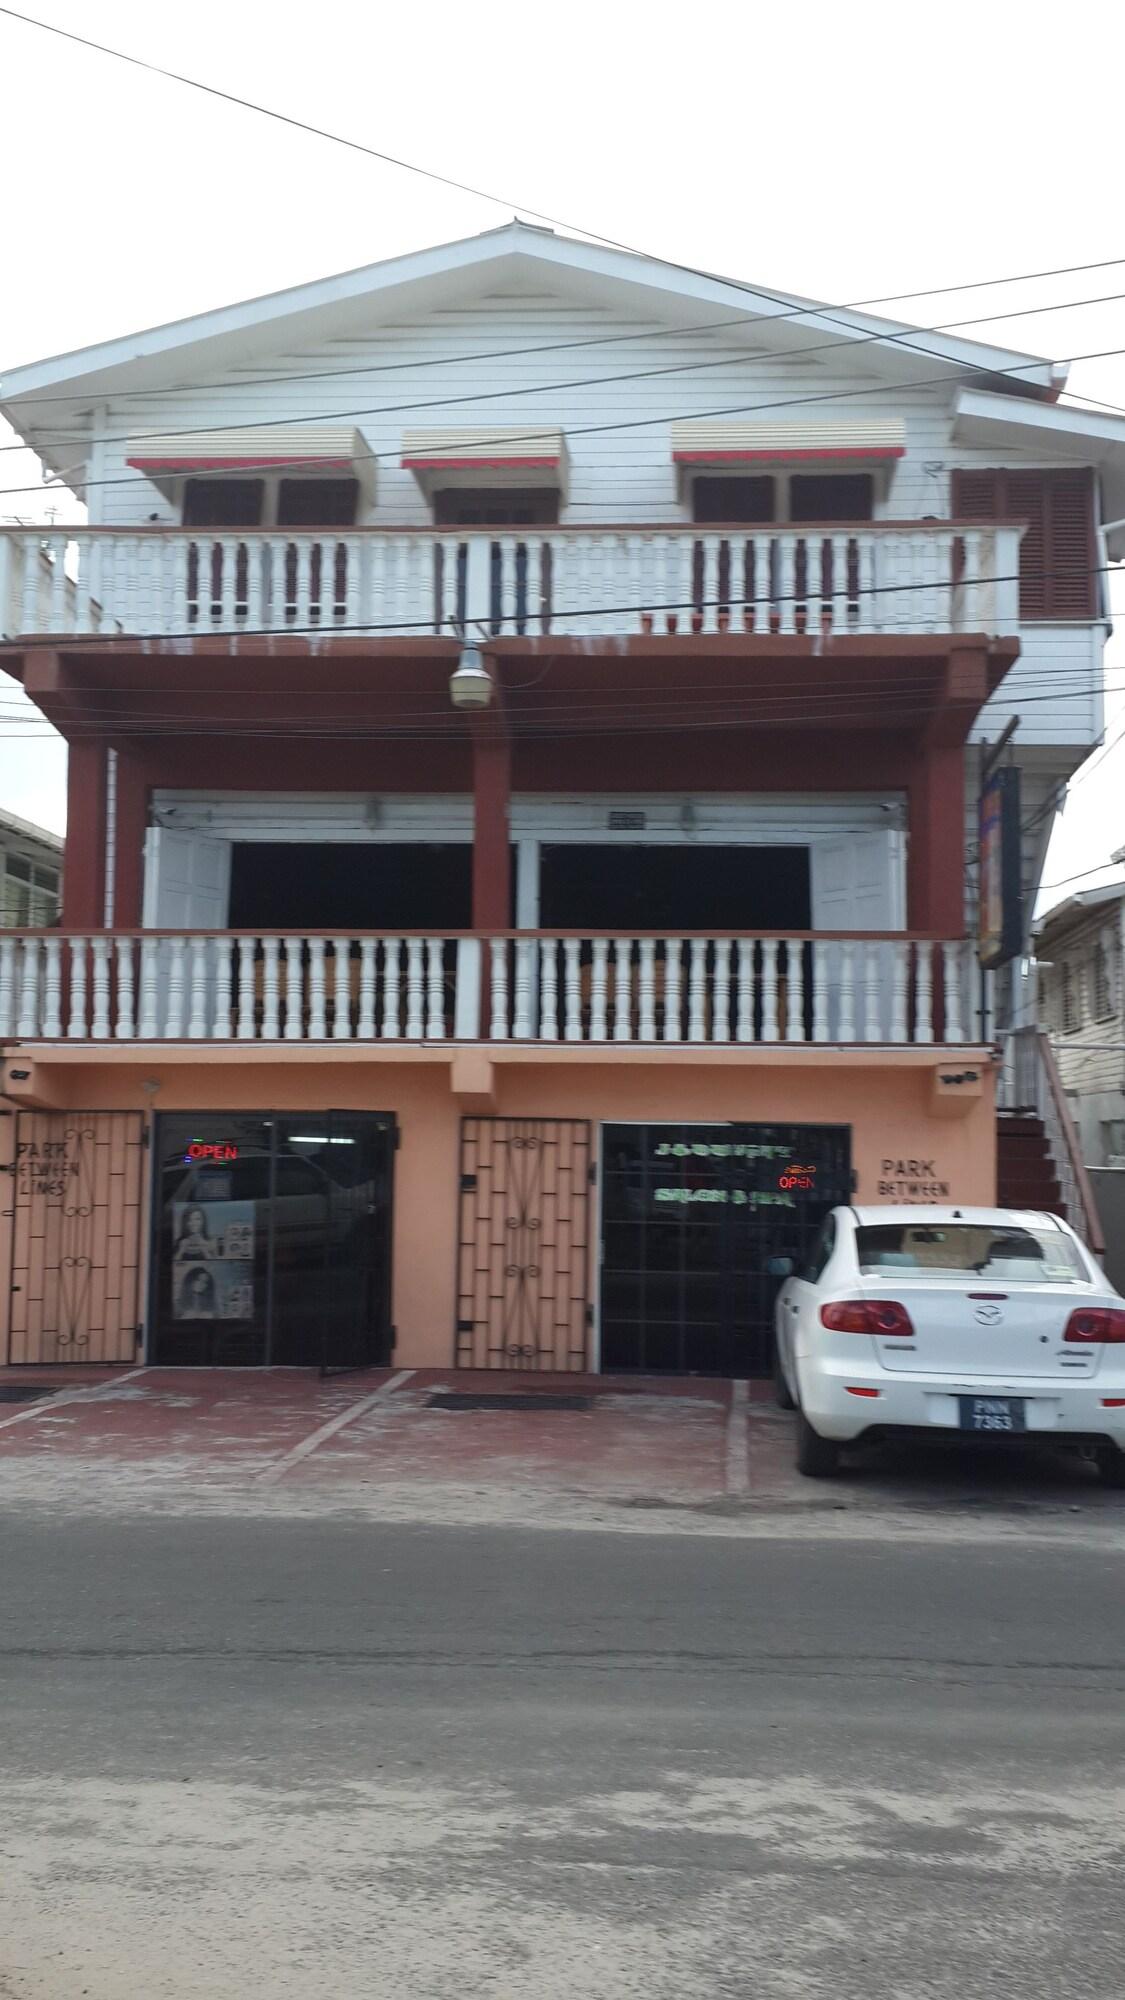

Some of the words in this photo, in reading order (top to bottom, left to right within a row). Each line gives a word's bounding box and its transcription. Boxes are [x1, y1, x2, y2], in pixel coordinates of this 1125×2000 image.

[16, 1142, 68, 1158] PARK
[187, 1144, 239, 1159] OPEN
[881, 1159, 937, 1177] PARK
[20, 1180, 66, 1196] LINES
[778, 1176, 815, 1188] OPEN
[878, 1180, 949, 1196] BETWEEN
